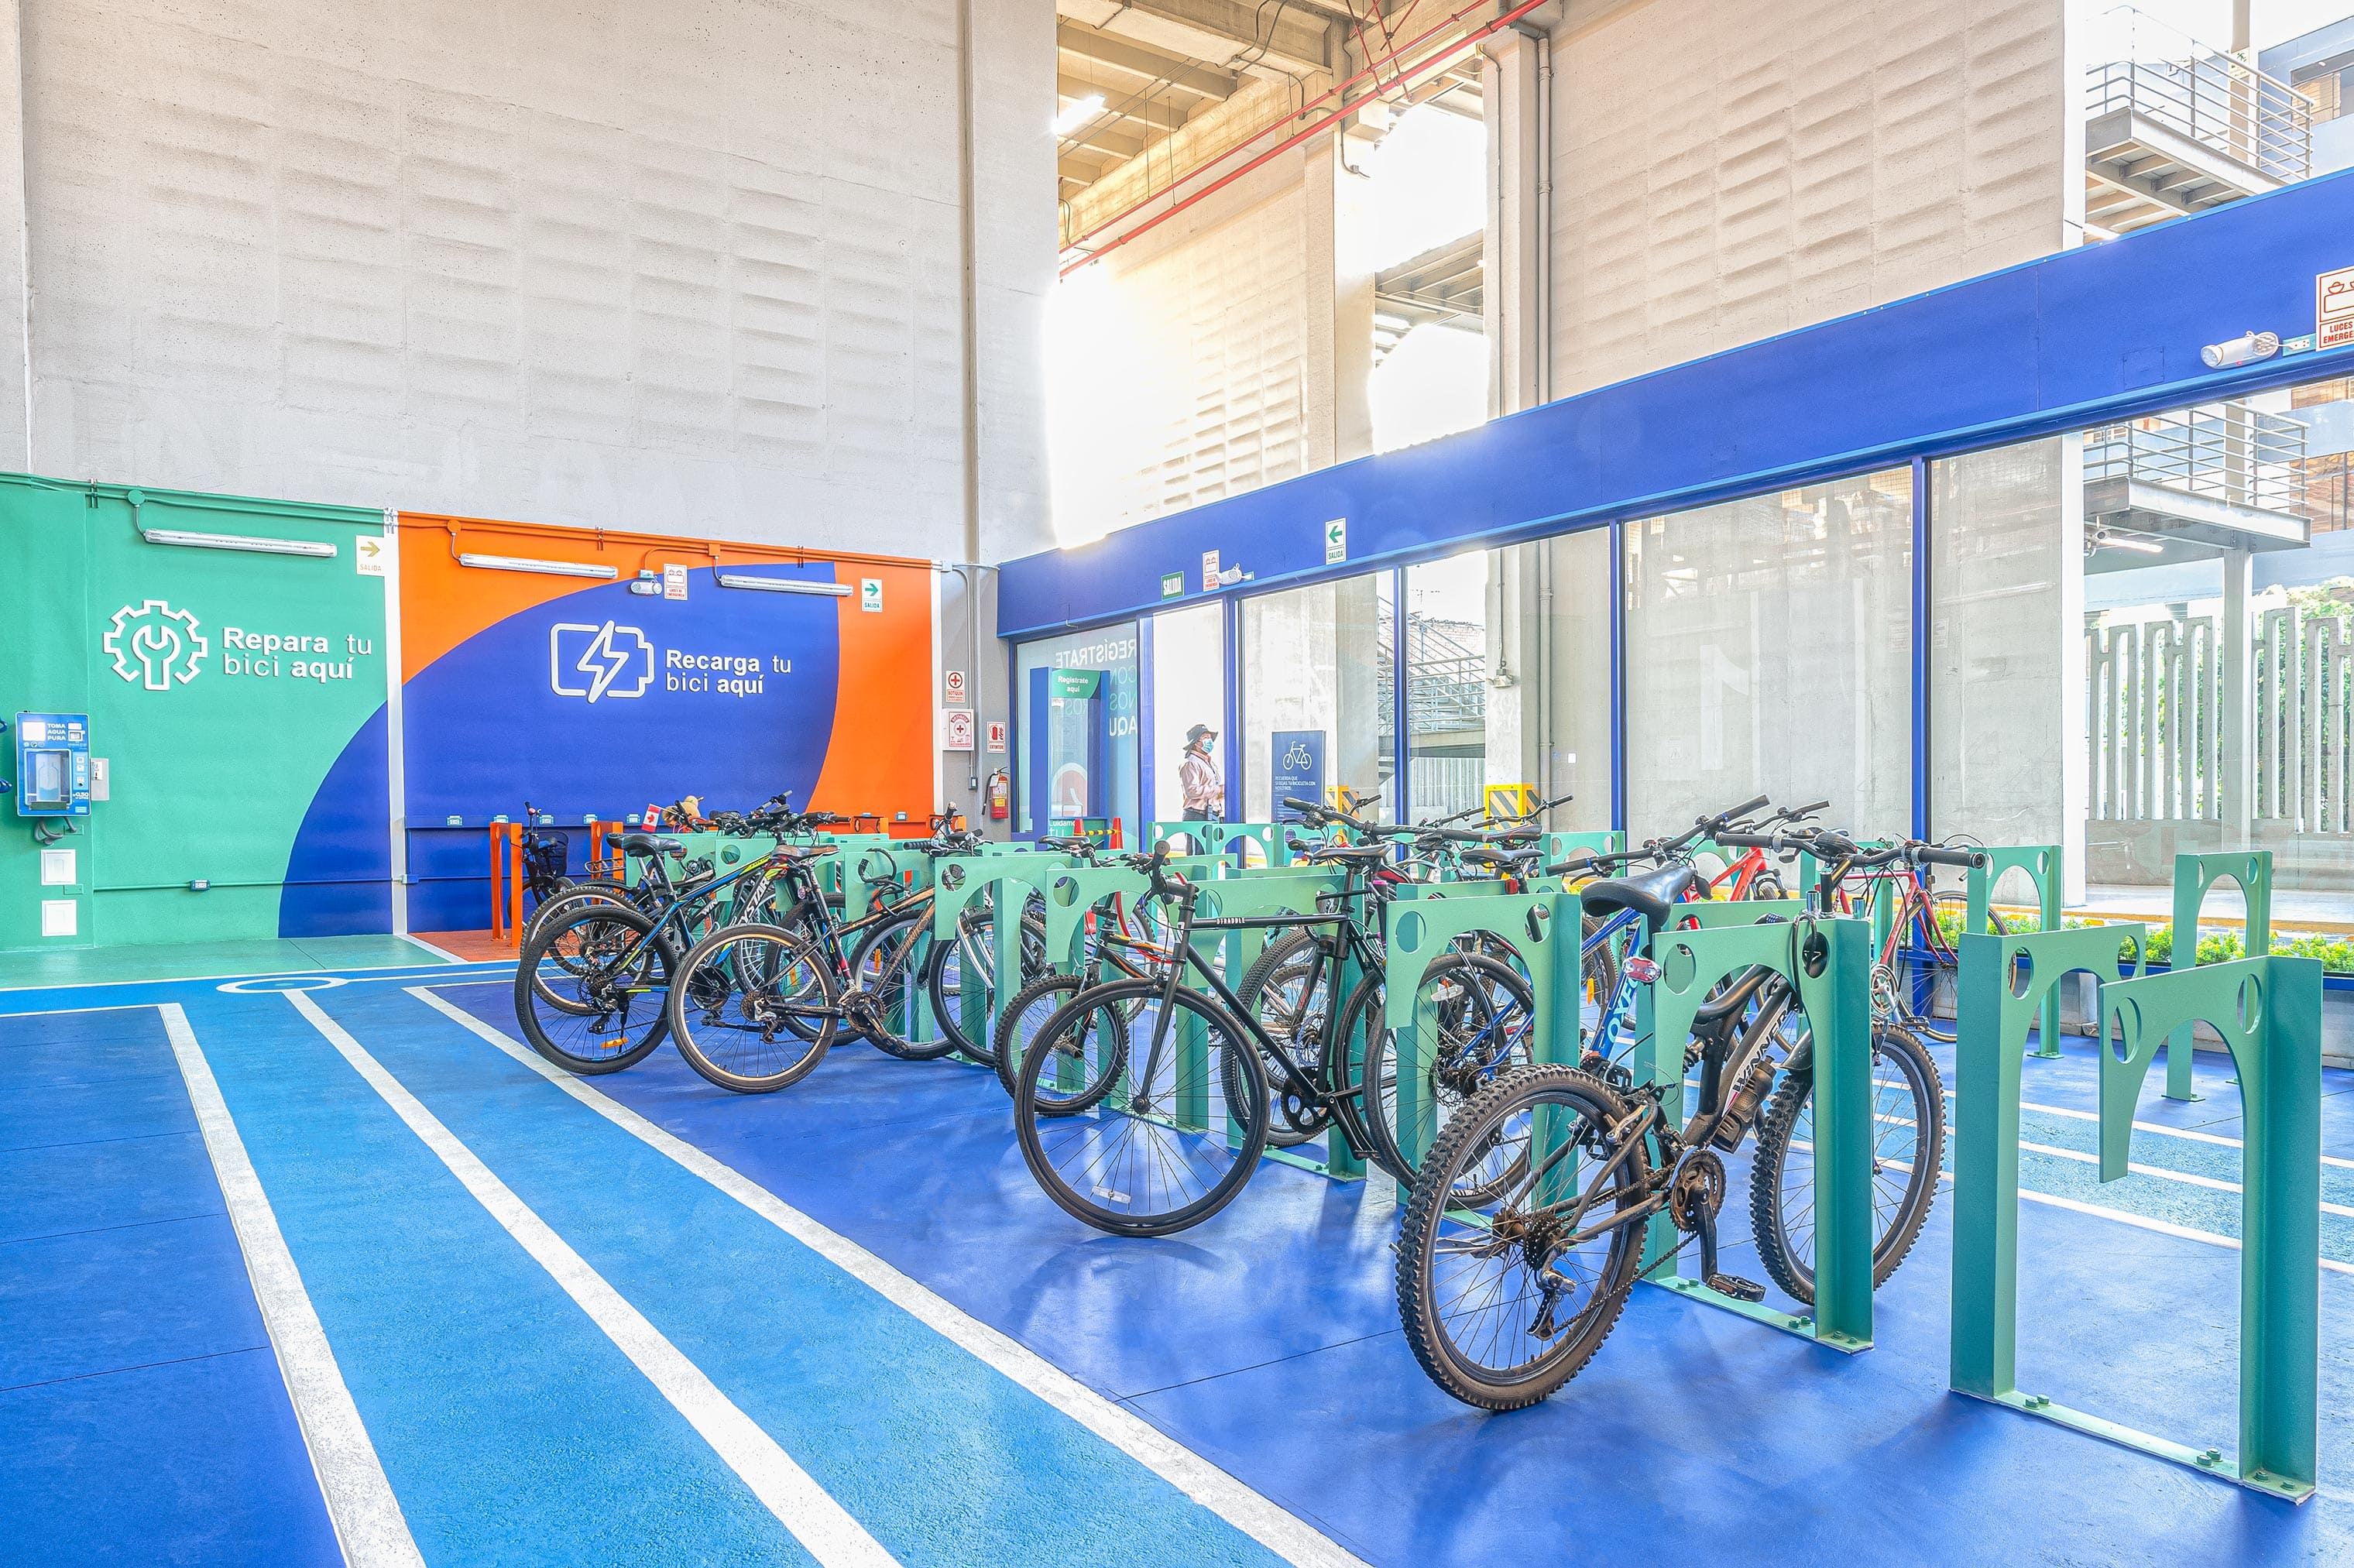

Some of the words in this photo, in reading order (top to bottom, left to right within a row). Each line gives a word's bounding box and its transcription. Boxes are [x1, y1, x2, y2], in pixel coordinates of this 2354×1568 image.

[2329, 321, 2353, 333] LUCES
[1328, 551, 1343, 559] SALIDA
[1162, 576, 1182, 596] SALIDA
[222, 626, 328, 656] Repara
[346, 633, 372, 655] tu
[223, 652, 279, 677] bici
[290, 657, 355, 684] aquí
[665, 649, 760, 676] Recarga
[771, 654, 791, 673] tu
[665, 671, 709, 692] bici
[716, 674, 765, 698] aquí
[736, 876, 770, 925] YSTAR
[1732, 1009, 1788, 1093] WINNER
